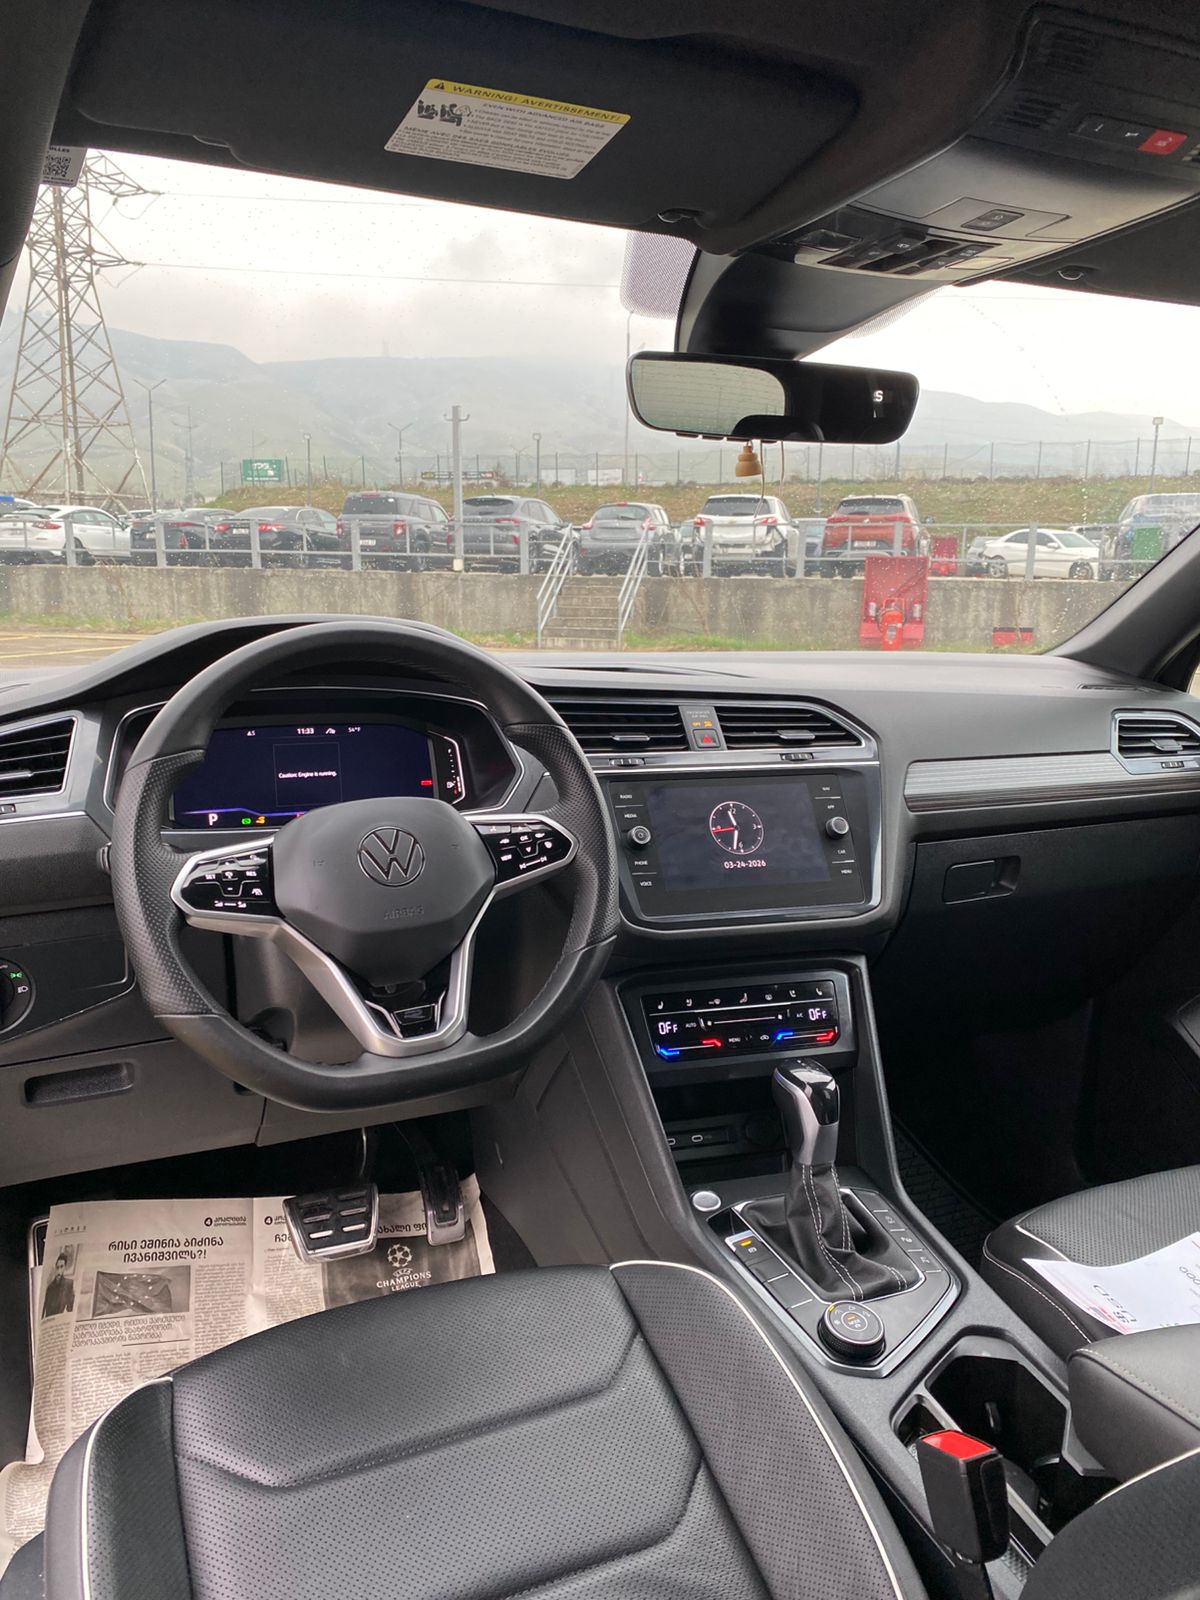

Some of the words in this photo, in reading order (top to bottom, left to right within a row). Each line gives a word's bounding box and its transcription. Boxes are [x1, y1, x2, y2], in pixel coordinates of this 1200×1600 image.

[453, 86, 518, 102] WARNING!
[521, 98, 622, 121] AVERTISSEMENT!
[875, 390, 884, 402] S
[297, 727, 314, 735] 11:33
[278, 771, 297, 779] Caution:
[208, 813, 218, 826] P
[723, 860, 767, 869] 03-24-2026
[378, 1223, 411, 1233] ახალი
[108, 1239, 138, 1251] რისი
[140, 1238, 181, 1250] ეშინია
[184, 1236, 224, 1248] ბიძინა
[123, 1249, 207, 1263] ივანიშვილს?!
[376, 1271, 432, 1288] CHAMPIONS
